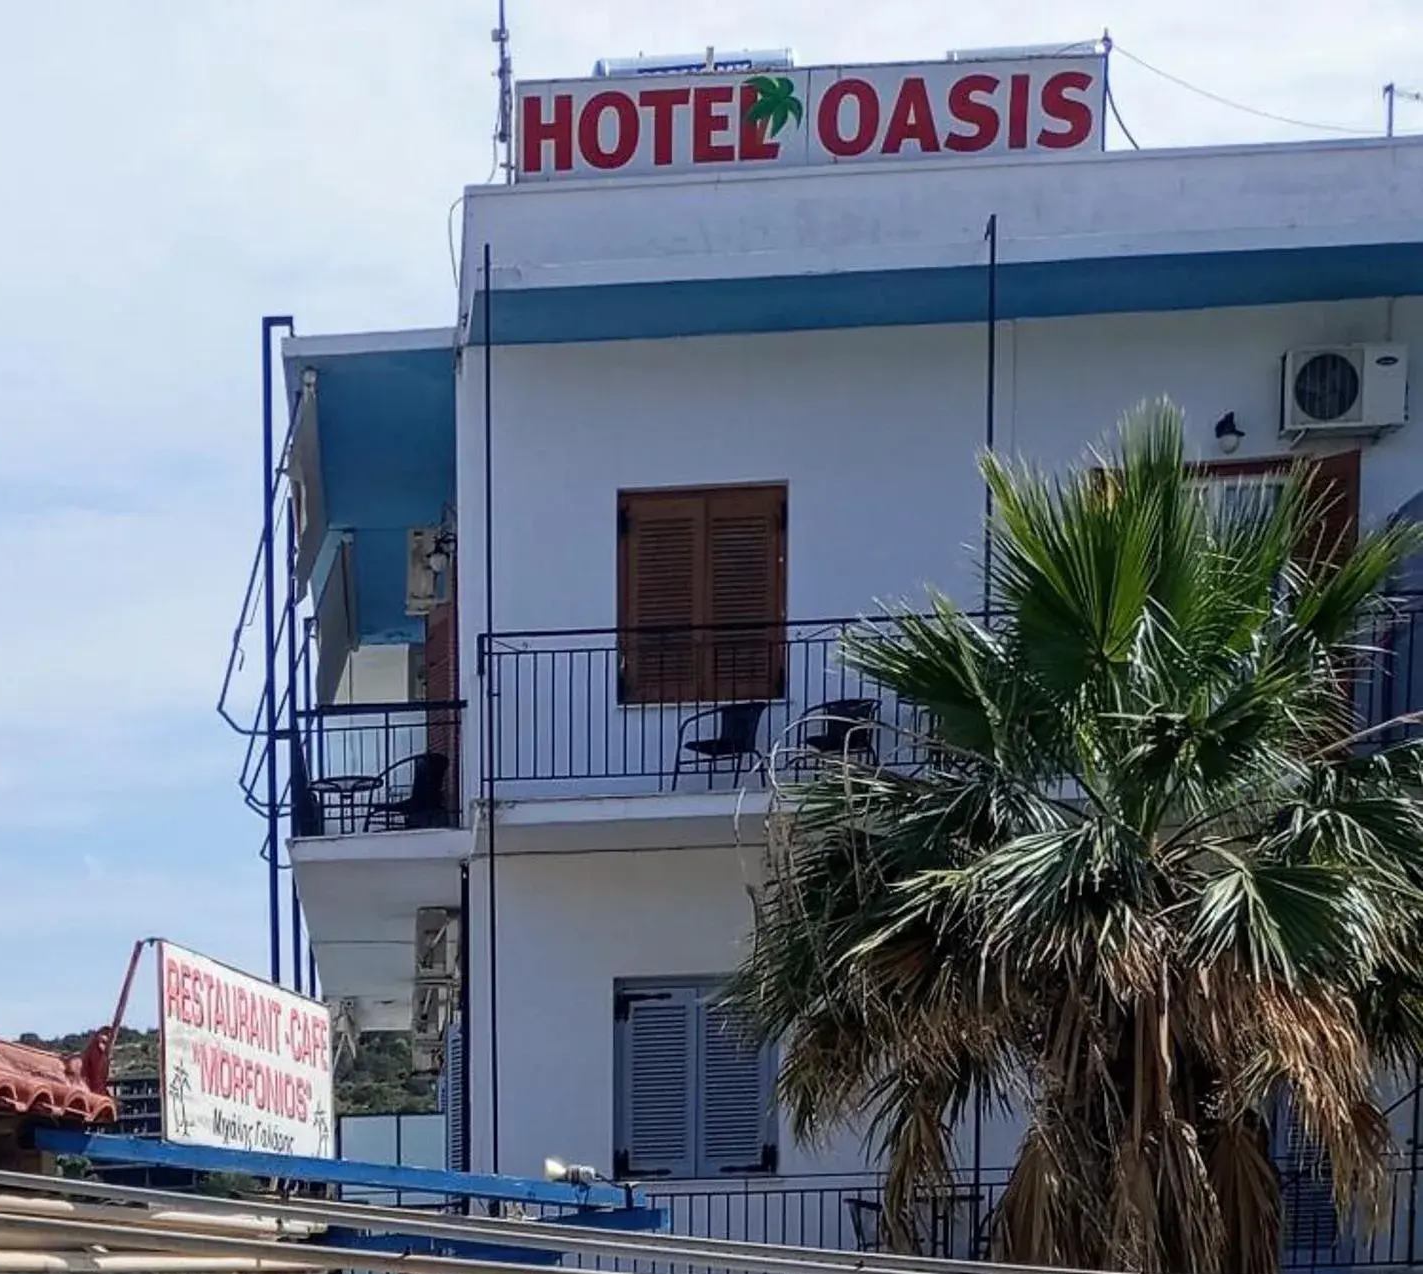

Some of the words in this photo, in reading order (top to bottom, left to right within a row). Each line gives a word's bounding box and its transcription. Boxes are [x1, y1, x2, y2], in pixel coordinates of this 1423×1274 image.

[523, 84, 779, 174] HOTEL
[815, 71, 1094, 158] OASIS
[166, 957, 282, 1057] RESTAURANT
